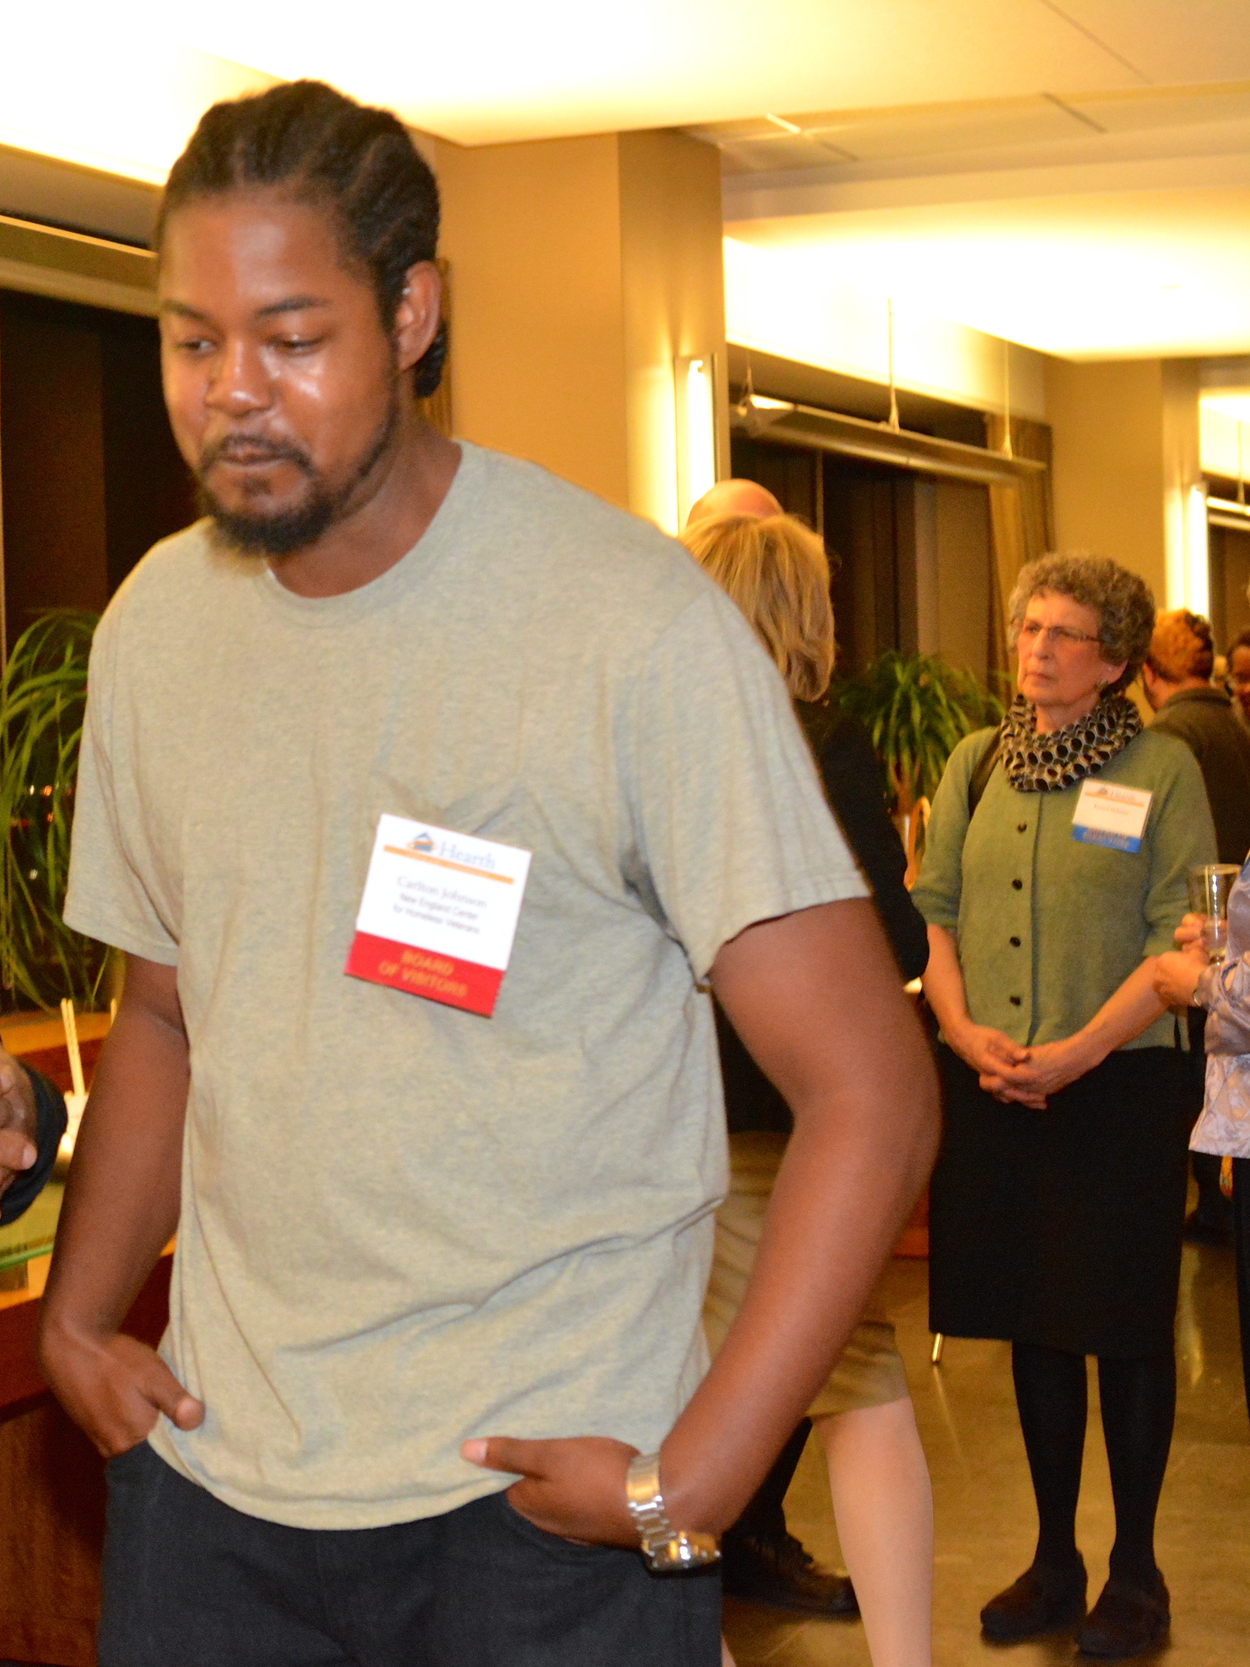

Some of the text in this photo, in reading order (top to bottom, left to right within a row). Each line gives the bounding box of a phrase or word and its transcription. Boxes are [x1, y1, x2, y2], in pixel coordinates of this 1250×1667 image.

[439, 841, 496, 870] Hearth
[397, 875, 439, 896] Carlton
[400, 893, 479, 920] New England Center
[401, 949, 455, 976] BOARD
